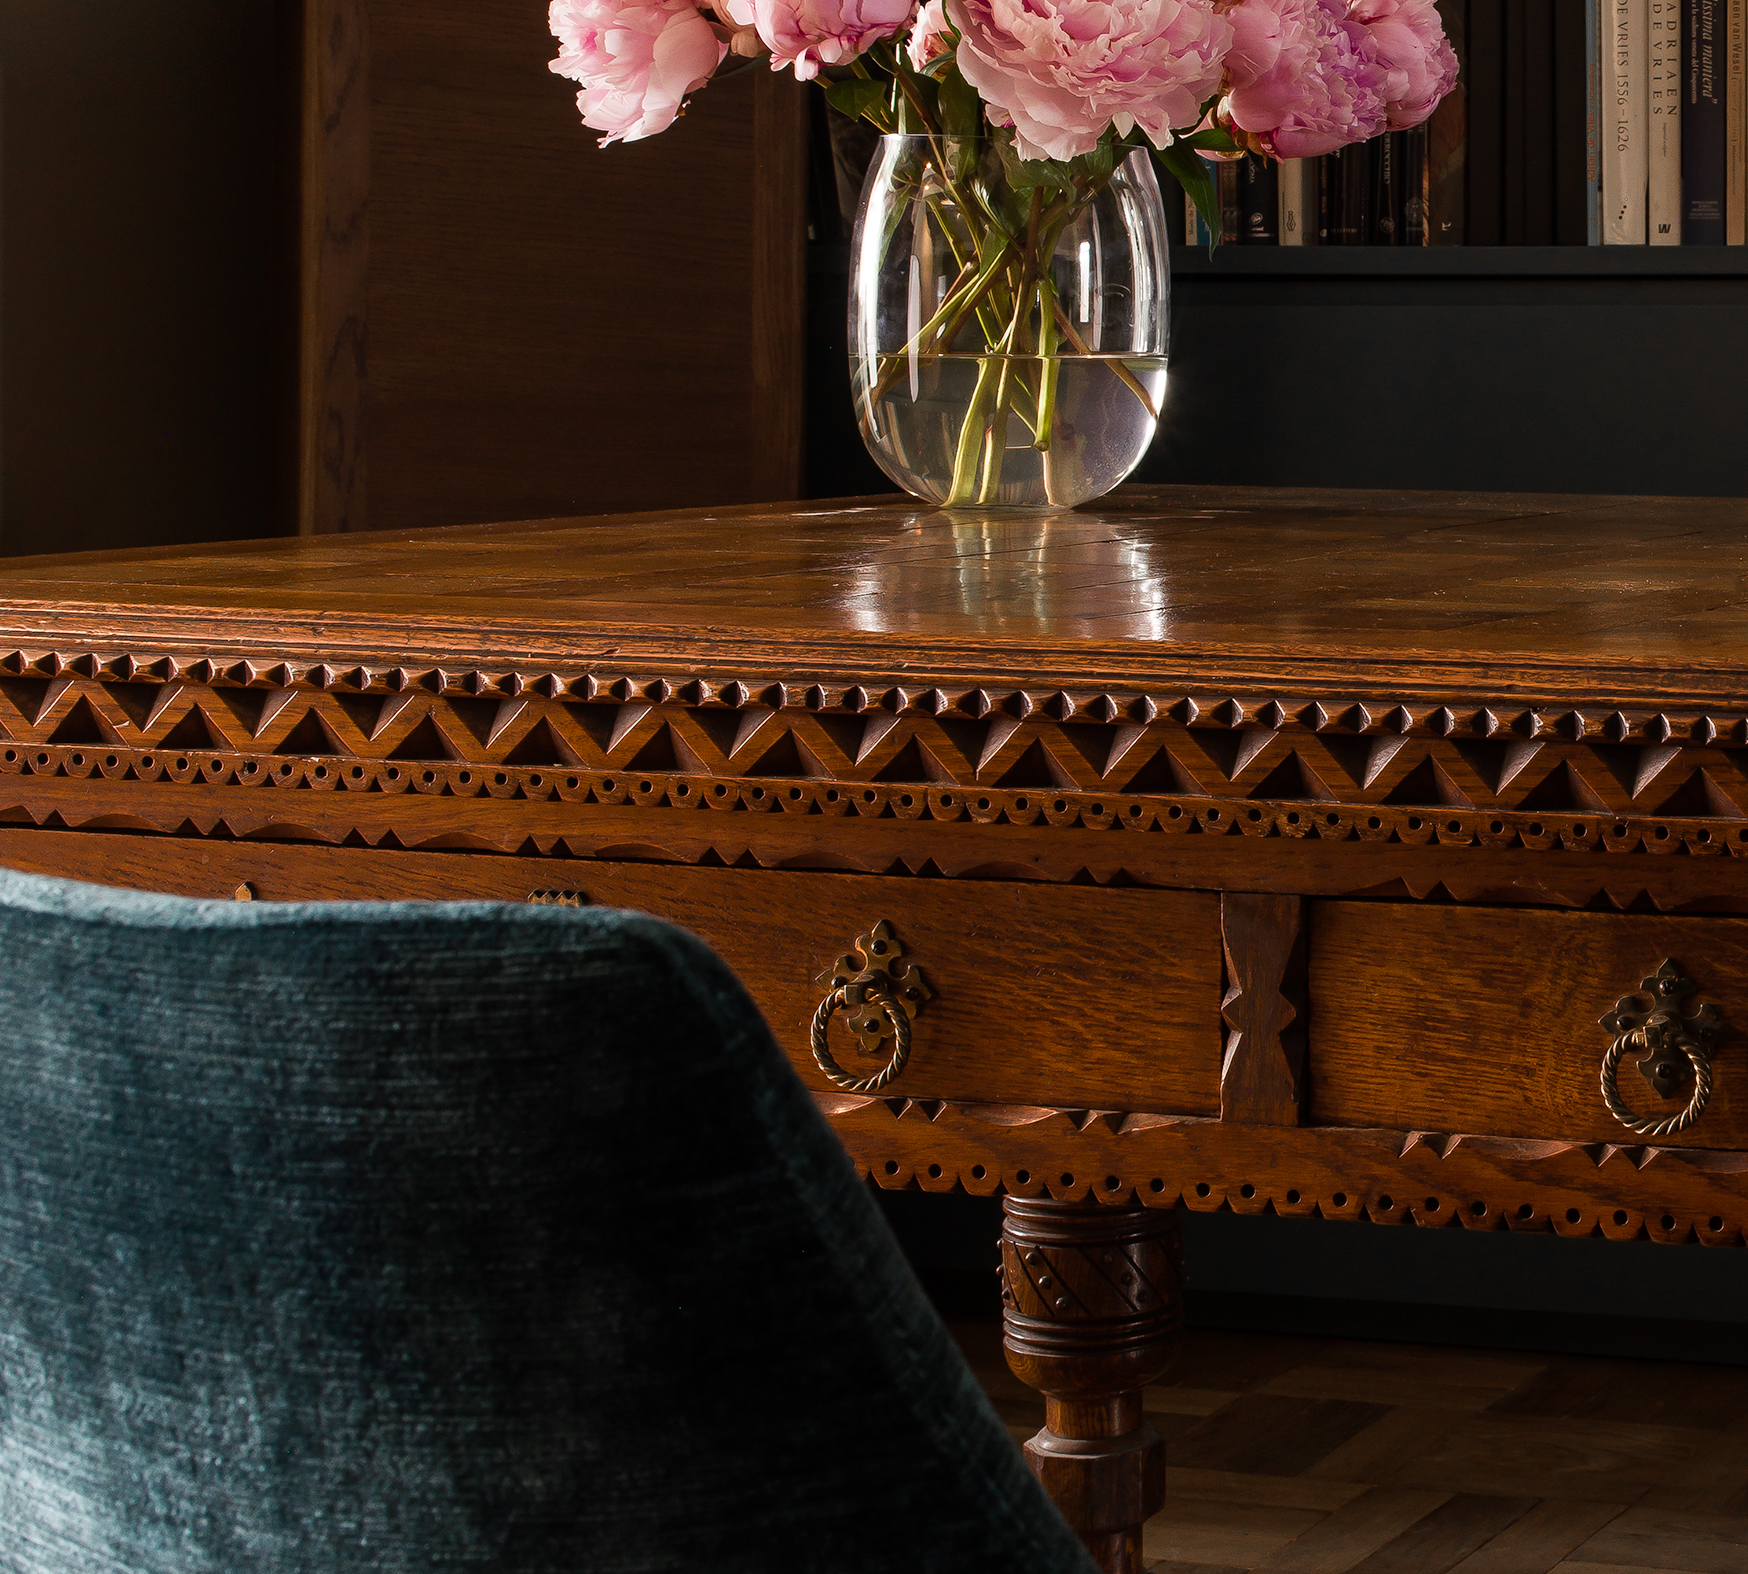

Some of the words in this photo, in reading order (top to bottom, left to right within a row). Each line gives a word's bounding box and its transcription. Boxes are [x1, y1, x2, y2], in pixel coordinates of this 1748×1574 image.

[1616, 20, 1628, 66] VRIES
[1651, 3, 1662, 30] DE
[1651, 41, 1663, 115] VRIES
[1664, 2, 1677, 116] ADRIAEN
